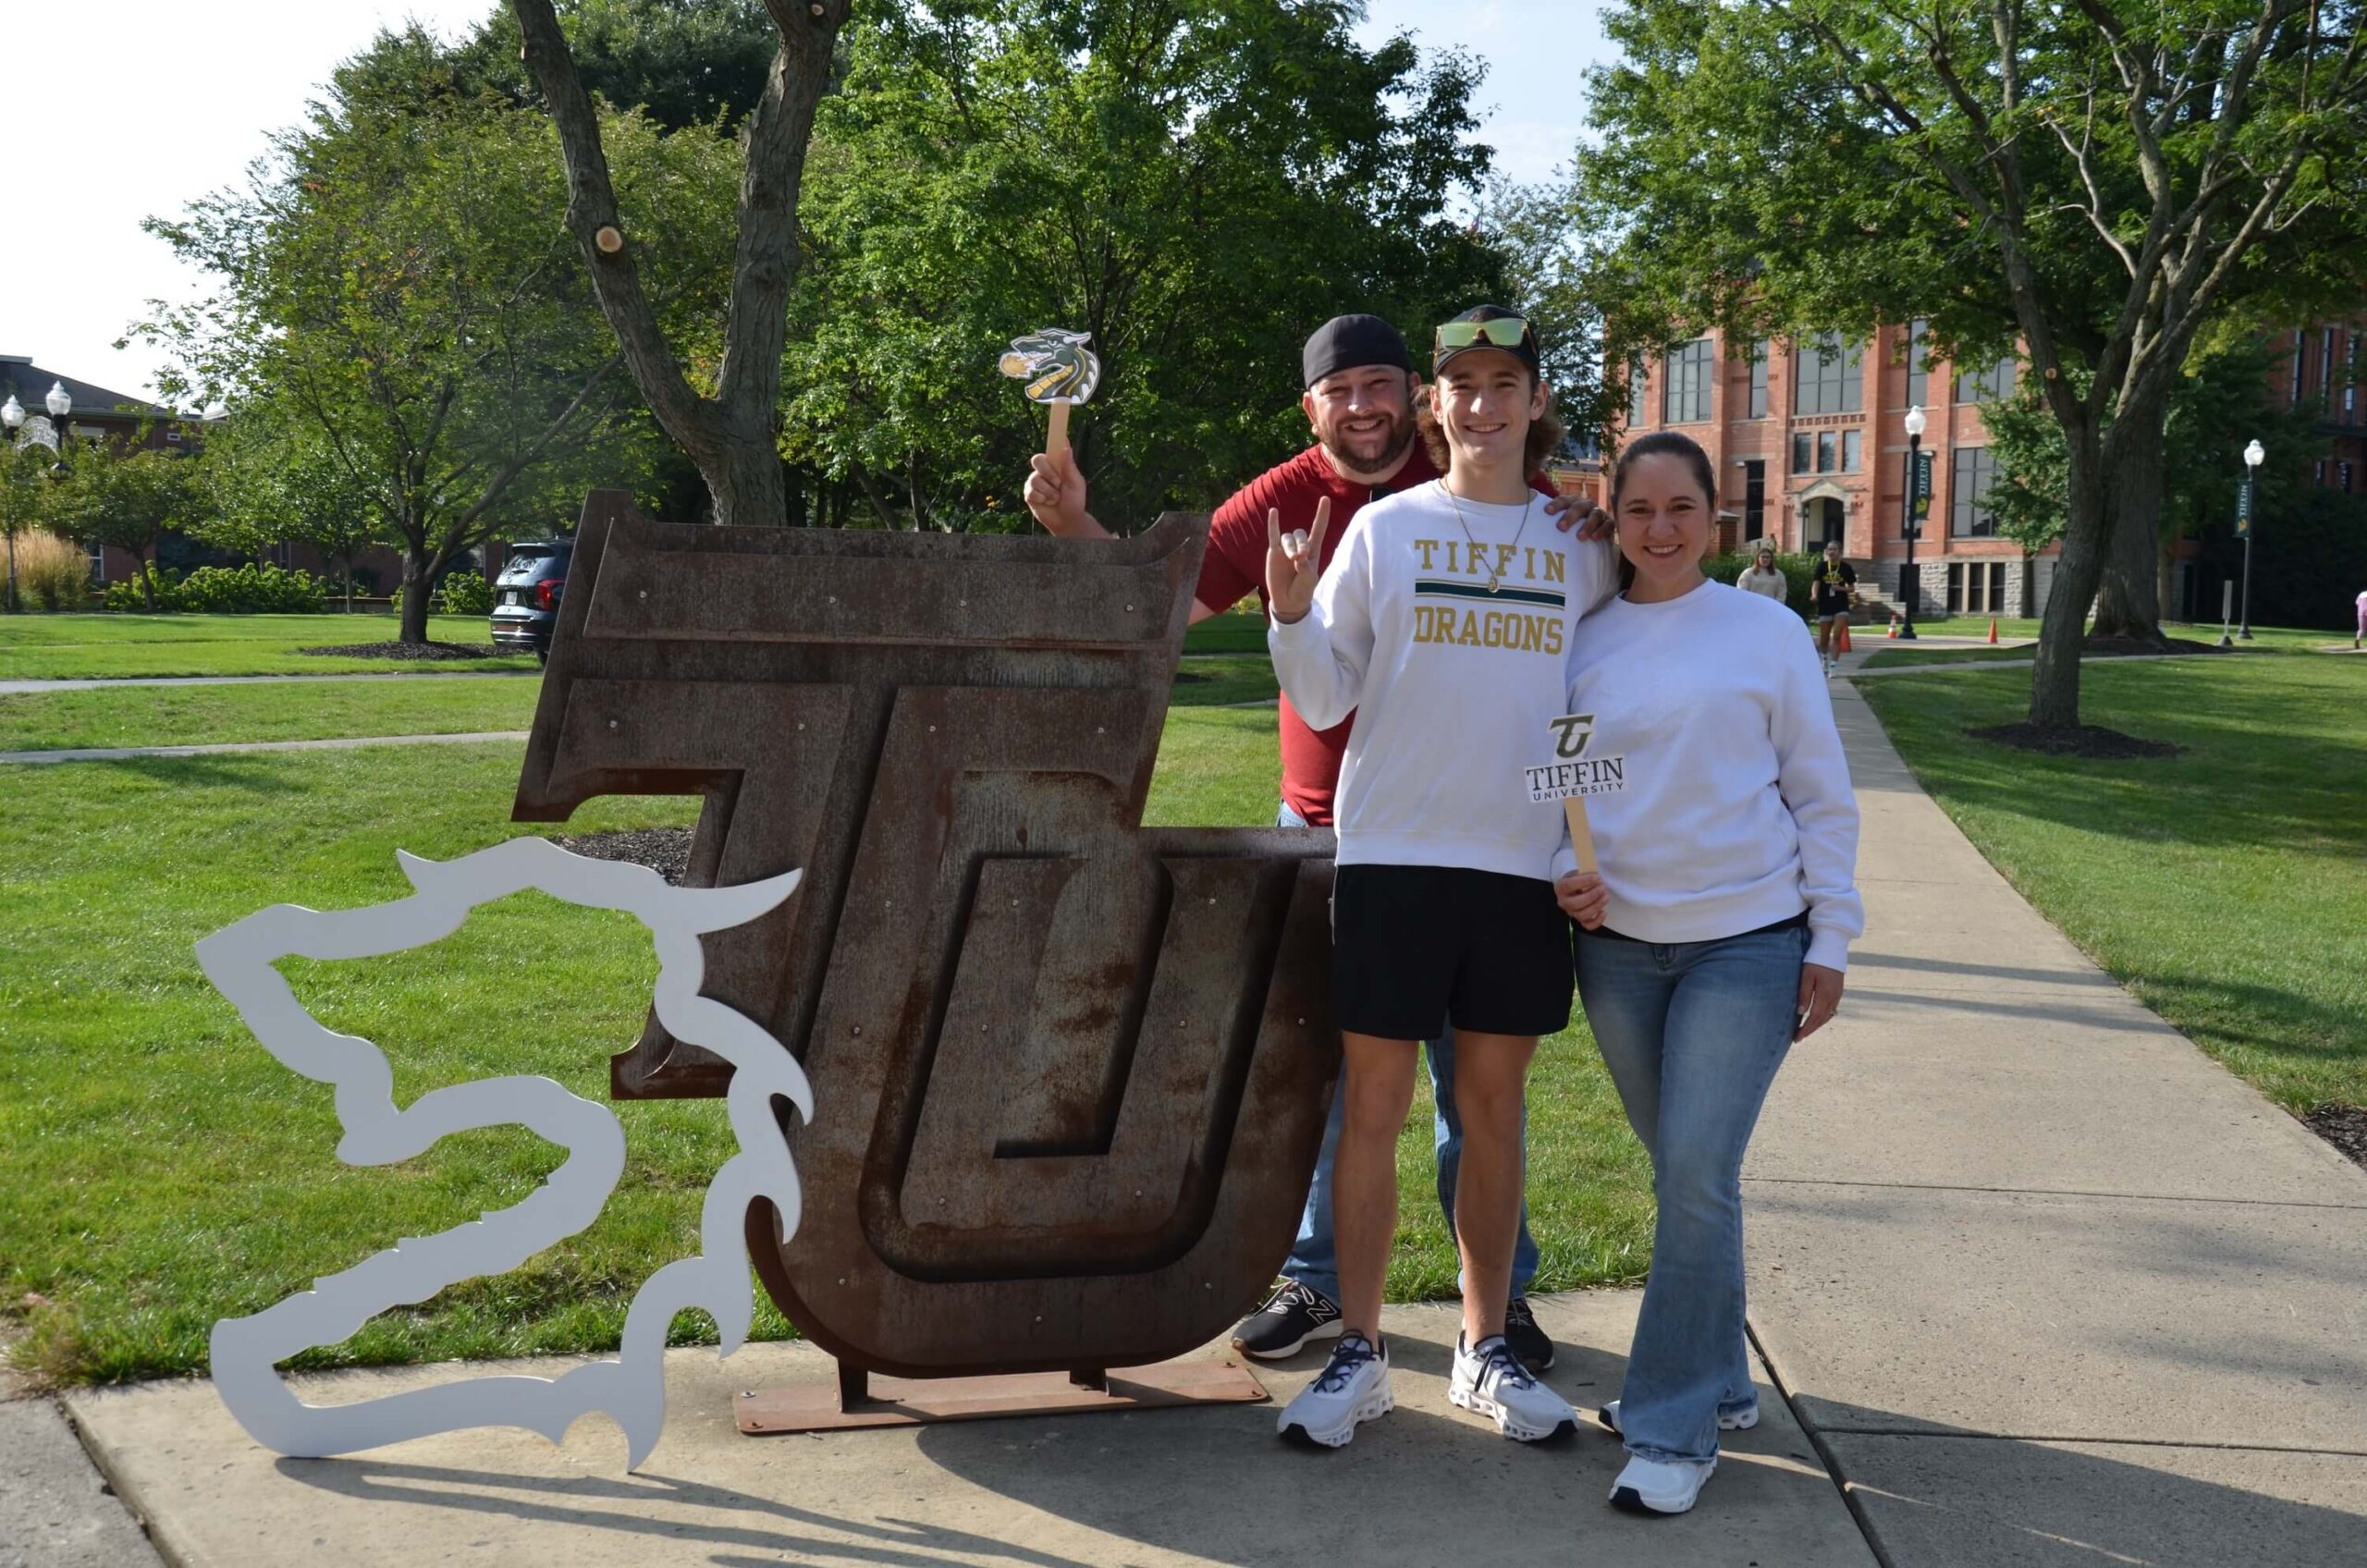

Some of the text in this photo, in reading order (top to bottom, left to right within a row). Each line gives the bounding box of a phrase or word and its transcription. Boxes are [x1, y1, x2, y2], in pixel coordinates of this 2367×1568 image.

[1415, 539, 1566, 583] TIFFIN
[1413, 606, 1564, 655] DRAGONS
[1526, 757, 1625, 792] TIFFIN
[1533, 781, 1625, 802] UNIVERSITY
